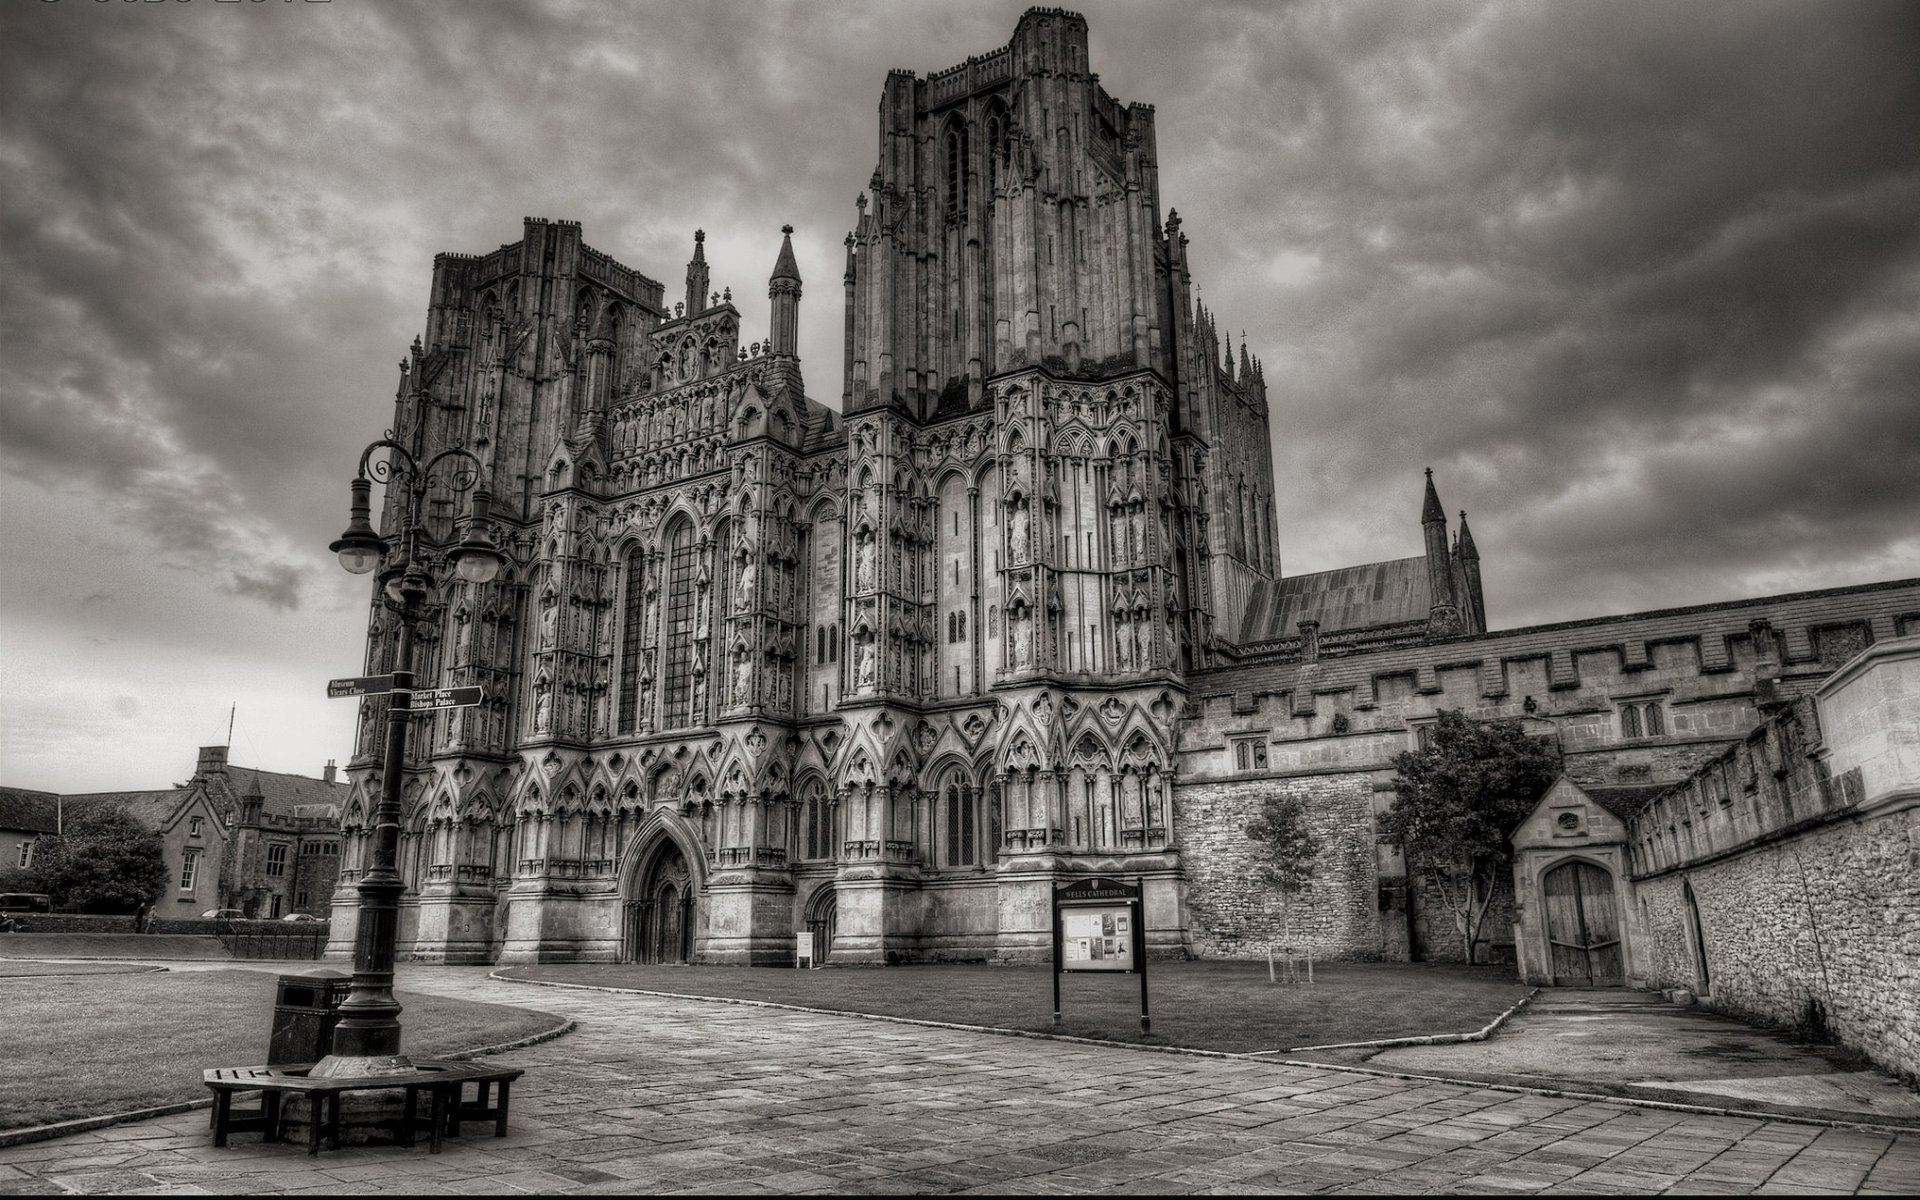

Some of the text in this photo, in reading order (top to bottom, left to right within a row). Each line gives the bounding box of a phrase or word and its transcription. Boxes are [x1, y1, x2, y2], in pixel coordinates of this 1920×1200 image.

[411, 690, 452, 700] Market Place
[410, 698, 456, 709] Bishops Palace
[1065, 889, 1127, 898] WELLS CATHEDRAL
